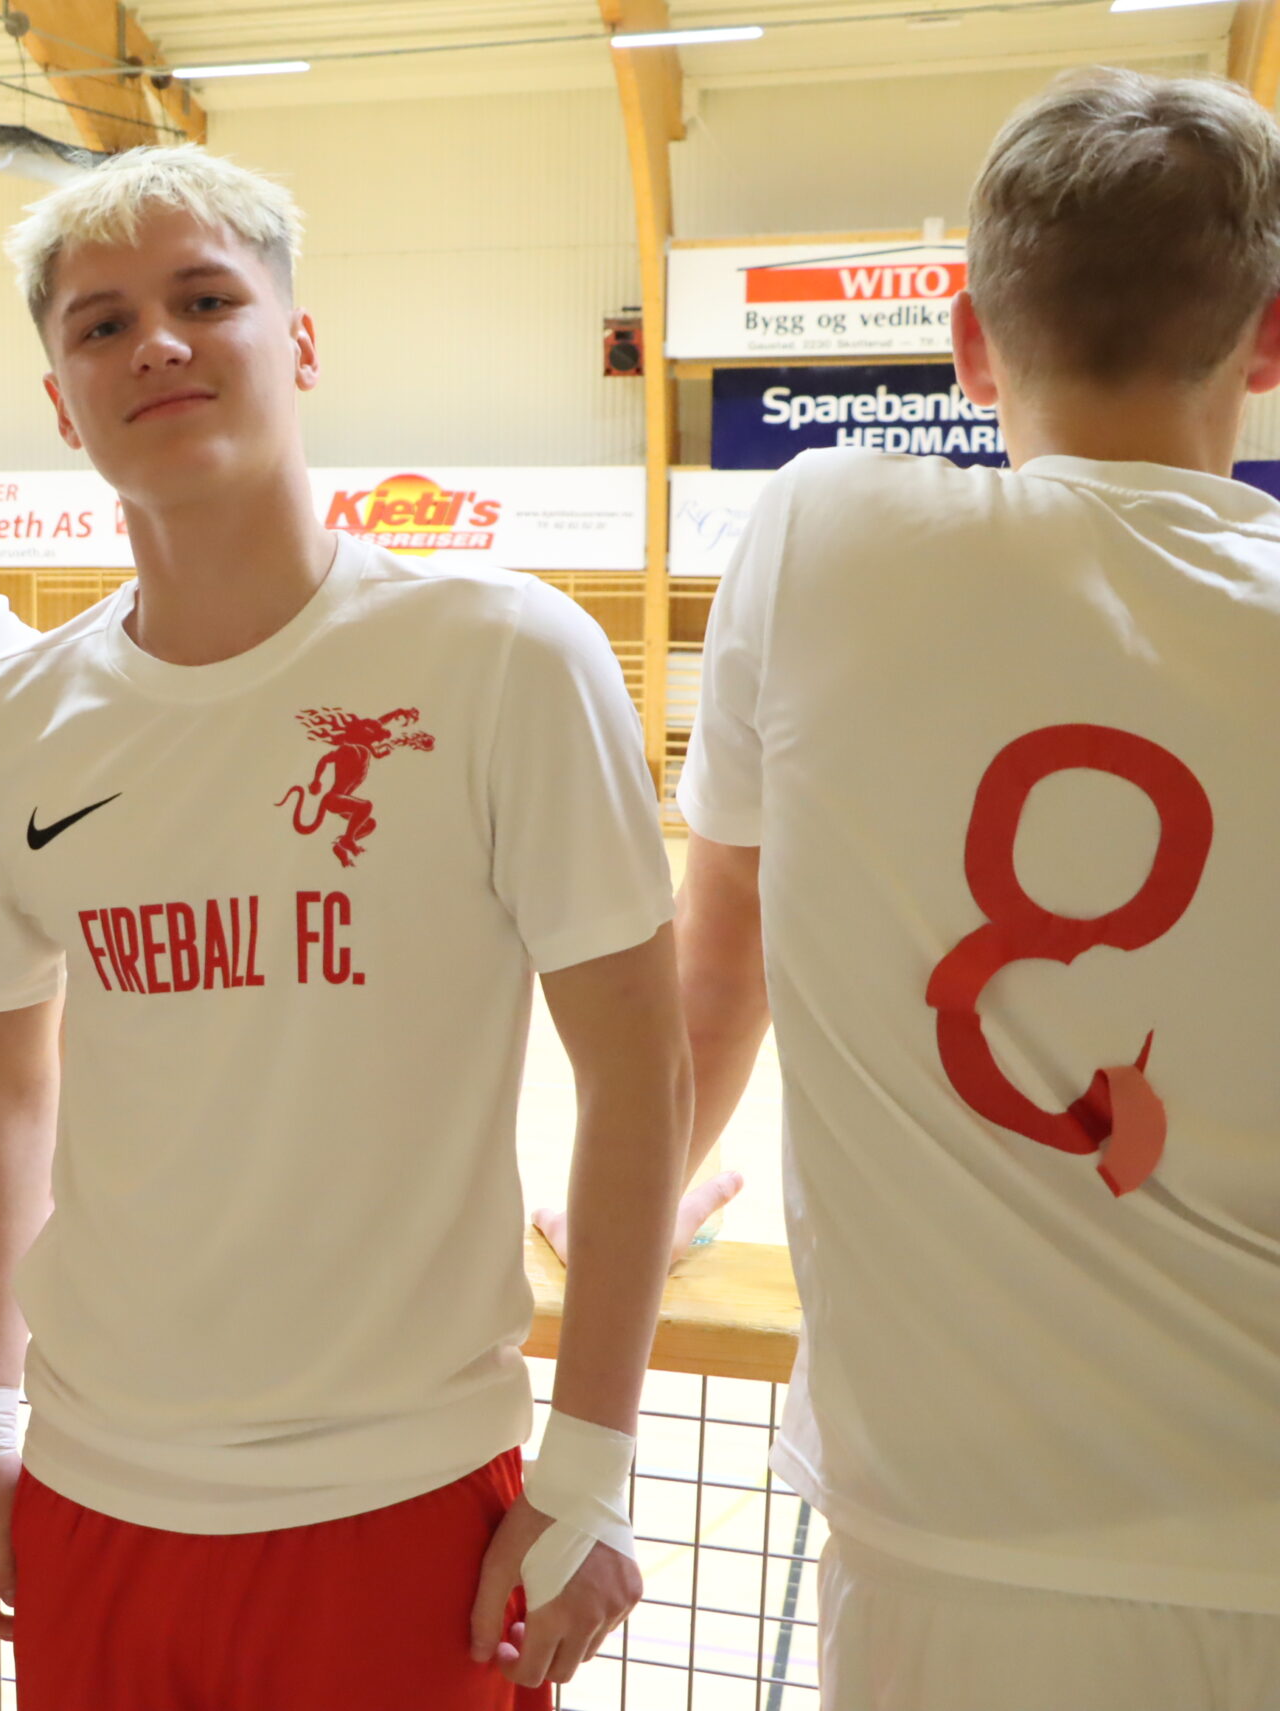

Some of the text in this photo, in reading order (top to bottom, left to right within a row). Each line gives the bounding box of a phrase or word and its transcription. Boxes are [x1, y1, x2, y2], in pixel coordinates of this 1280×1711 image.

[838, 265, 951, 299] WITO
[745, 311, 805, 335] Bygg
[817, 312, 847, 335] og
[52, 511, 94, 538] AS
[324, 490, 502, 534] Kjetil's
[350, 532, 490, 548] SSREISER
[78, 891, 365, 994] FIREBALL FC.
